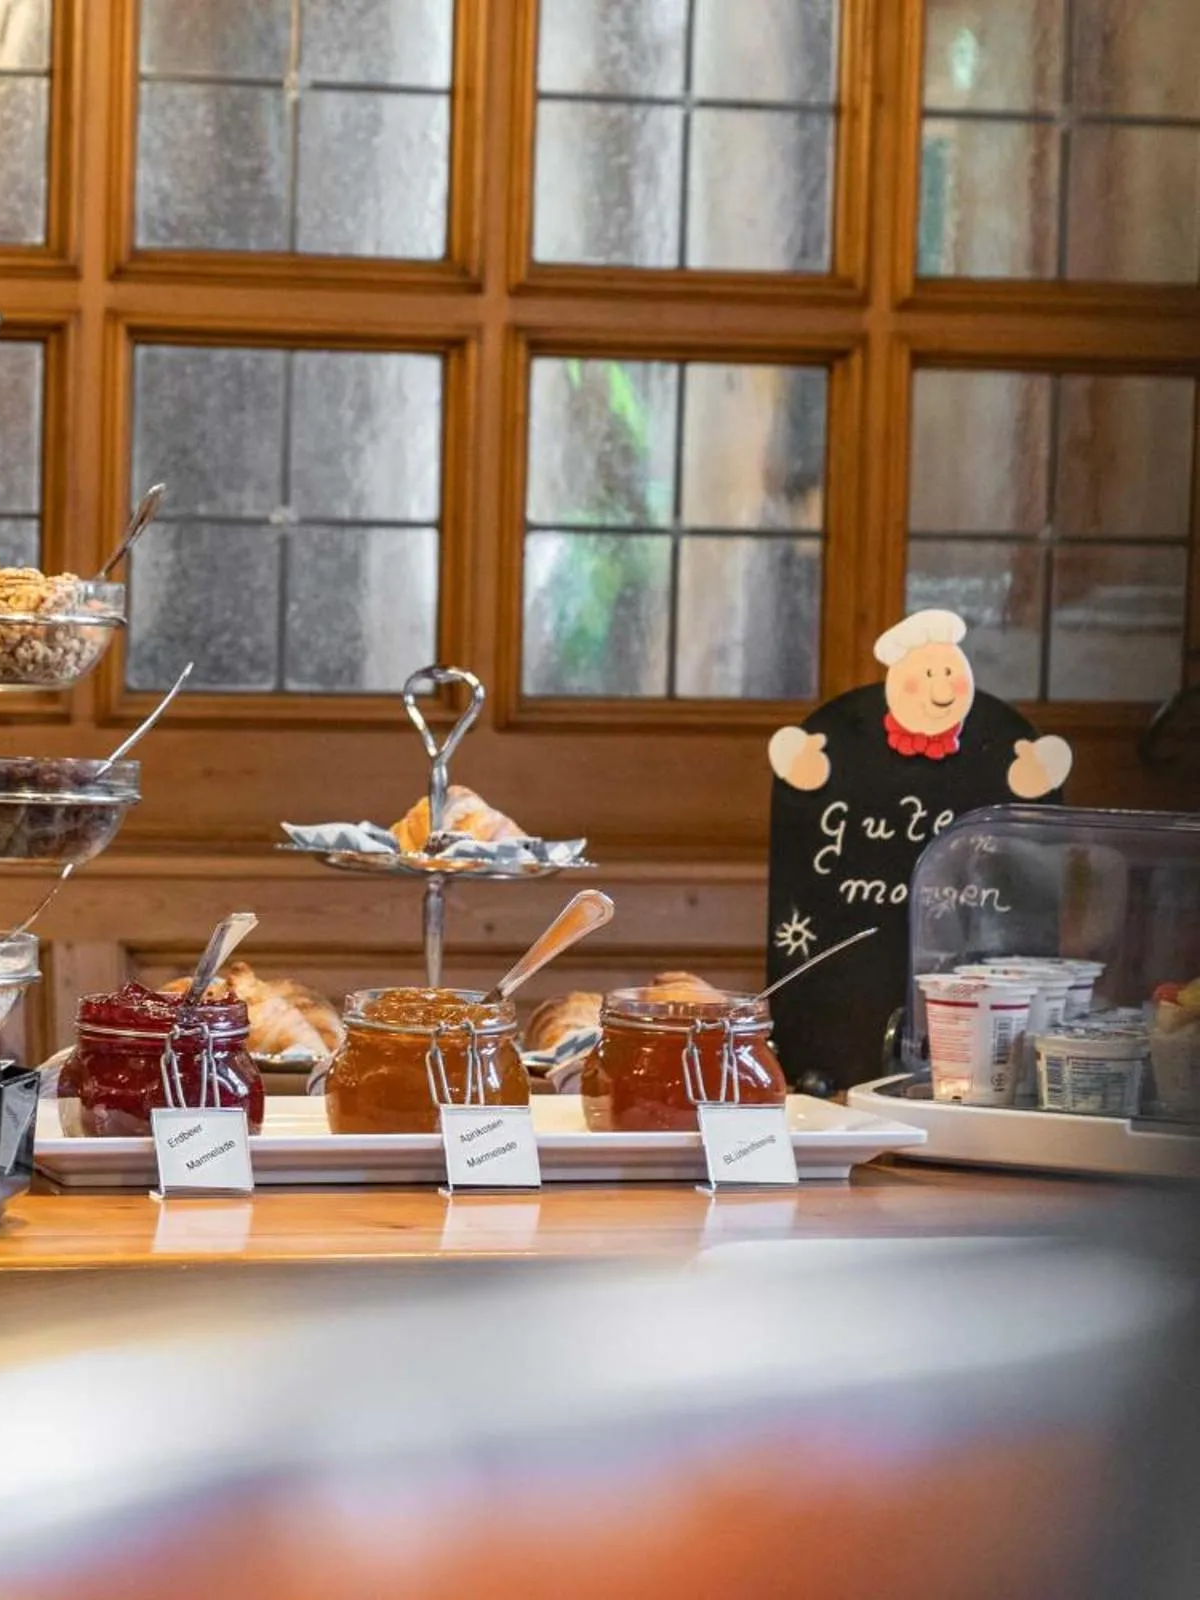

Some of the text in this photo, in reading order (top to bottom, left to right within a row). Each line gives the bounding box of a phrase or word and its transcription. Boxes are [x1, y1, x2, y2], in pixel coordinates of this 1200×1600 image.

[167, 1123, 203, 1149] Erdbeer
[459, 1118, 504, 1144] Aprikosen
[185, 1139, 237, 1171] Marmelade
[465, 1140, 518, 1169] Marmelade
